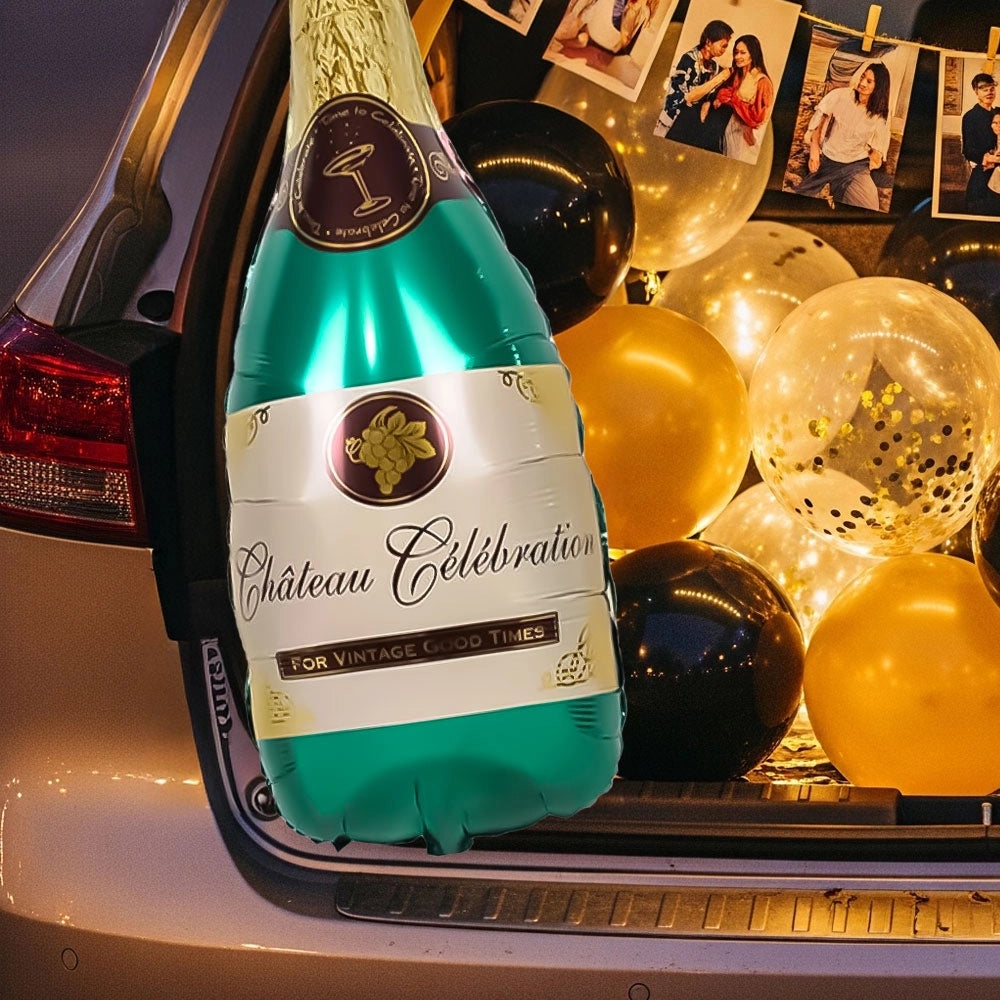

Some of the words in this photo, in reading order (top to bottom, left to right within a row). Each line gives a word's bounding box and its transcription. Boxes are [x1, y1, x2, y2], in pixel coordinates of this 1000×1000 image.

[237, 541, 374, 622] Château
[386, 515, 594, 606] Célébration
[291, 658, 327, 671] FOR
[333, 644, 418, 666] VINTAGE
[423, 634, 482, 654] GOOD
[488, 625, 545, 646] TIMES
